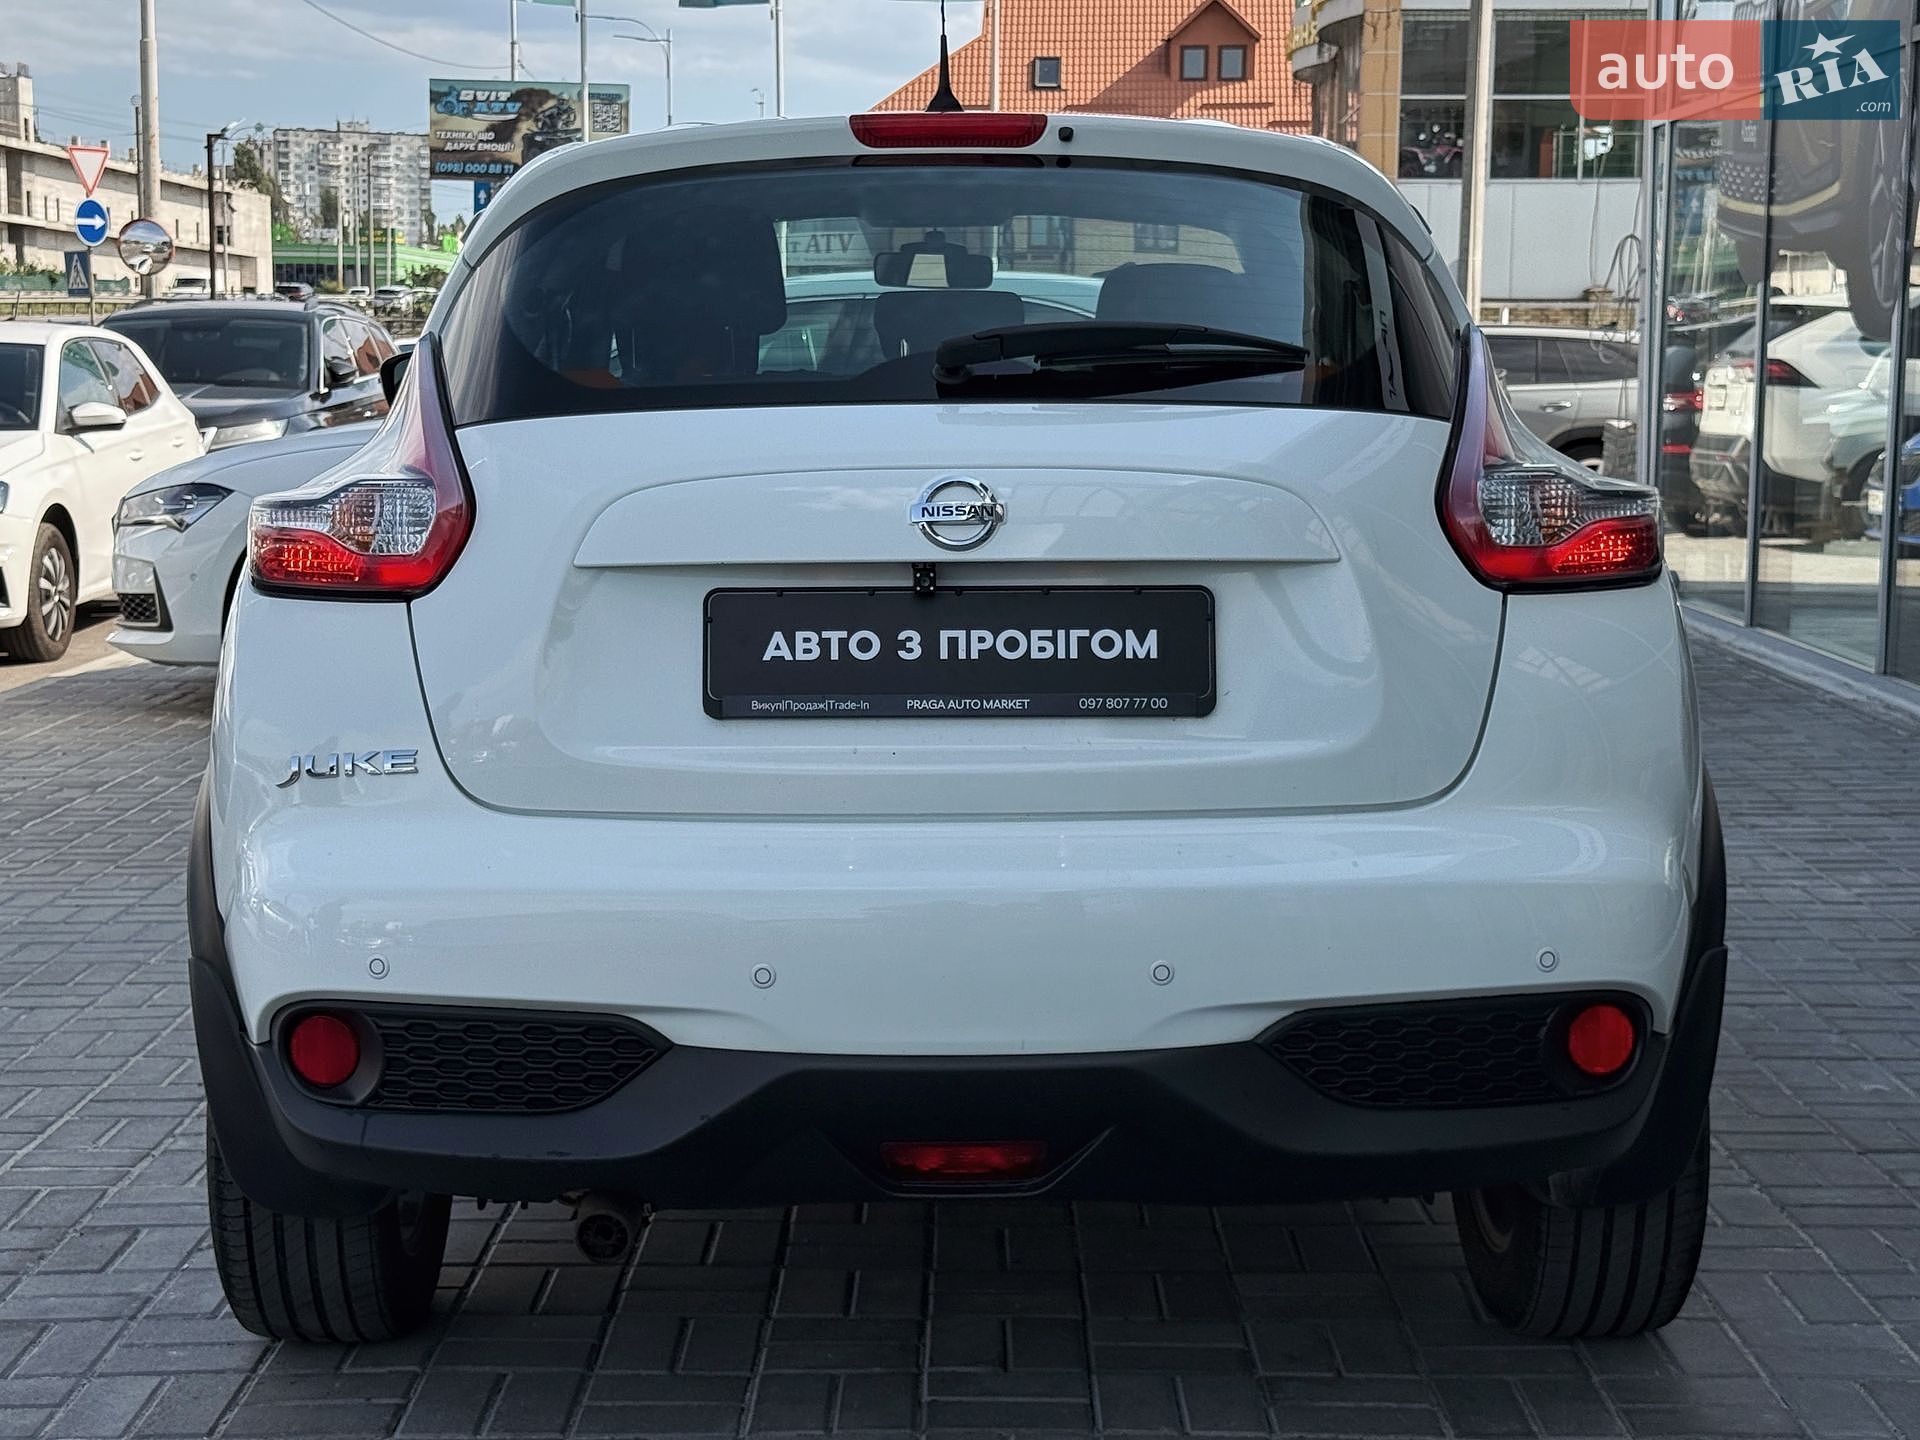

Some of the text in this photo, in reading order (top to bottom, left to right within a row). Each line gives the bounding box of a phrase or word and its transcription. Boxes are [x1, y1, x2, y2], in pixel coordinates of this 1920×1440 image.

[464, 164, 488, 174] 000
[806, 233, 855, 254] ATV
[921, 504, 994, 518] NISSAN
[762, 629, 1158, 661] АВТО З ПРОБІГОМ
[906, 699, 1030, 710] PRAGA AUTO MARKET
[1079, 698, 1168, 709] 097 807 77 00
[275, 749, 419, 789] JUKE
